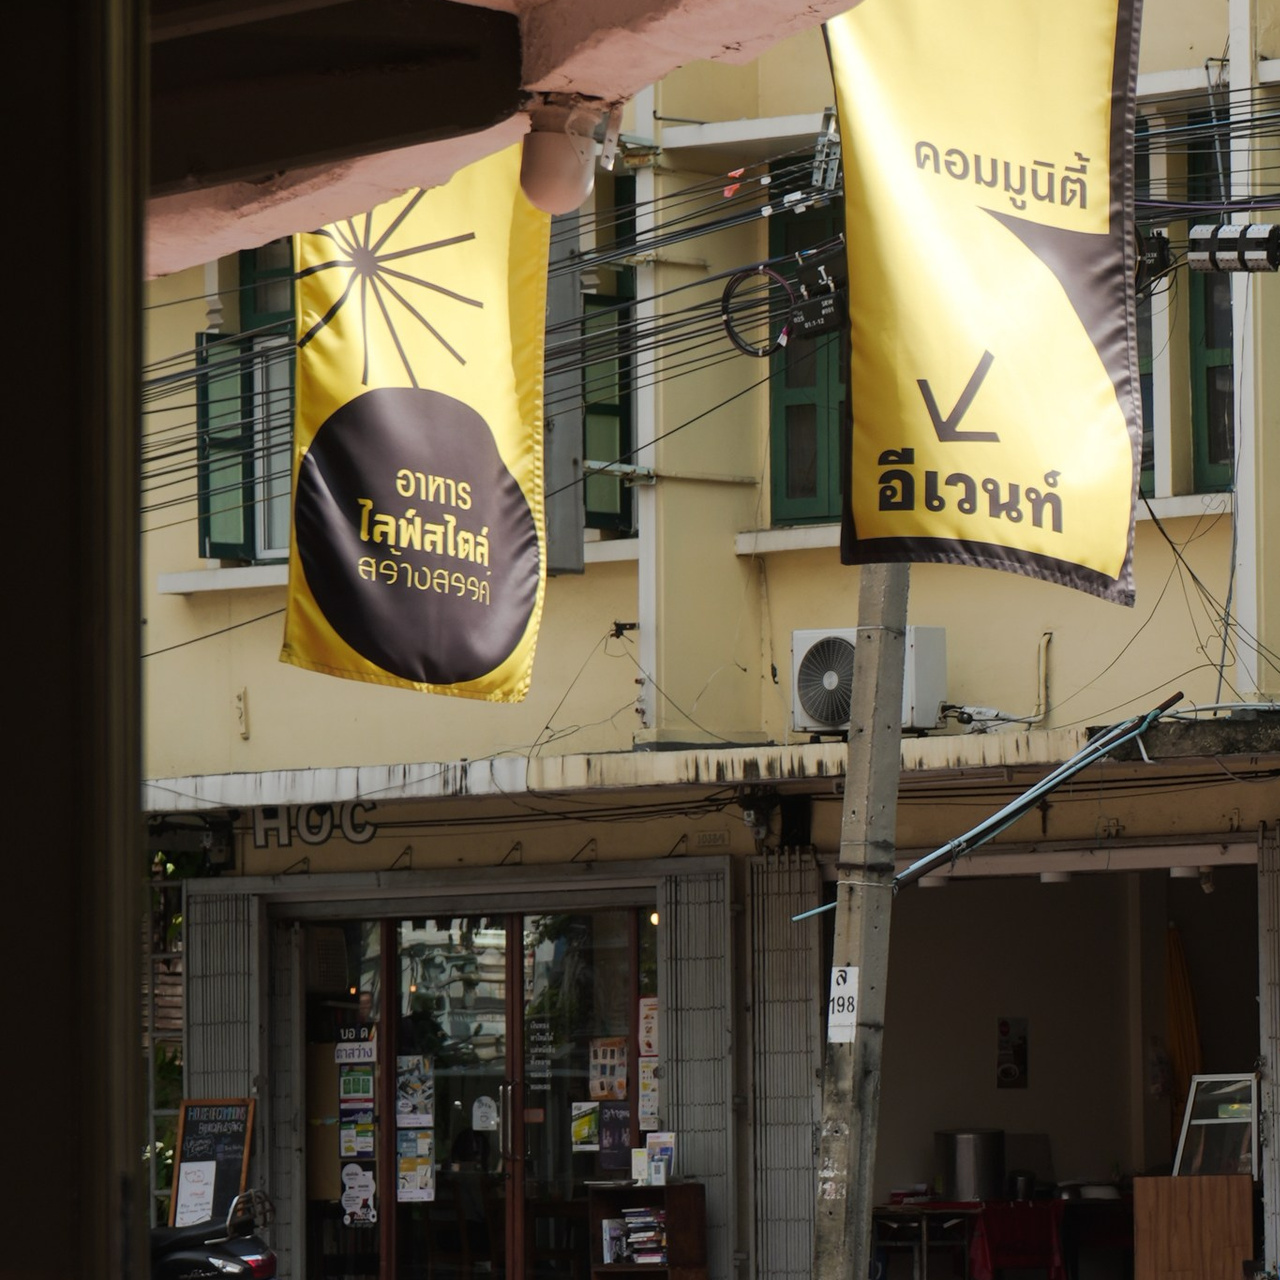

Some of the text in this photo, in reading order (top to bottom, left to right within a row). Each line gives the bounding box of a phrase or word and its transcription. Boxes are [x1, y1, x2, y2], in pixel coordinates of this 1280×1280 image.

[914, 140, 1091, 210] คอมมูนิตี้
[395, 468, 473, 510] อาหาร
[877, 448, 1064, 534] อีเวนท์
[357, 498, 489, 568] ไลฟ์สไตล์
[357, 548, 492, 606] สร้างสรรค์
[829, 995, 855, 1015] 198
